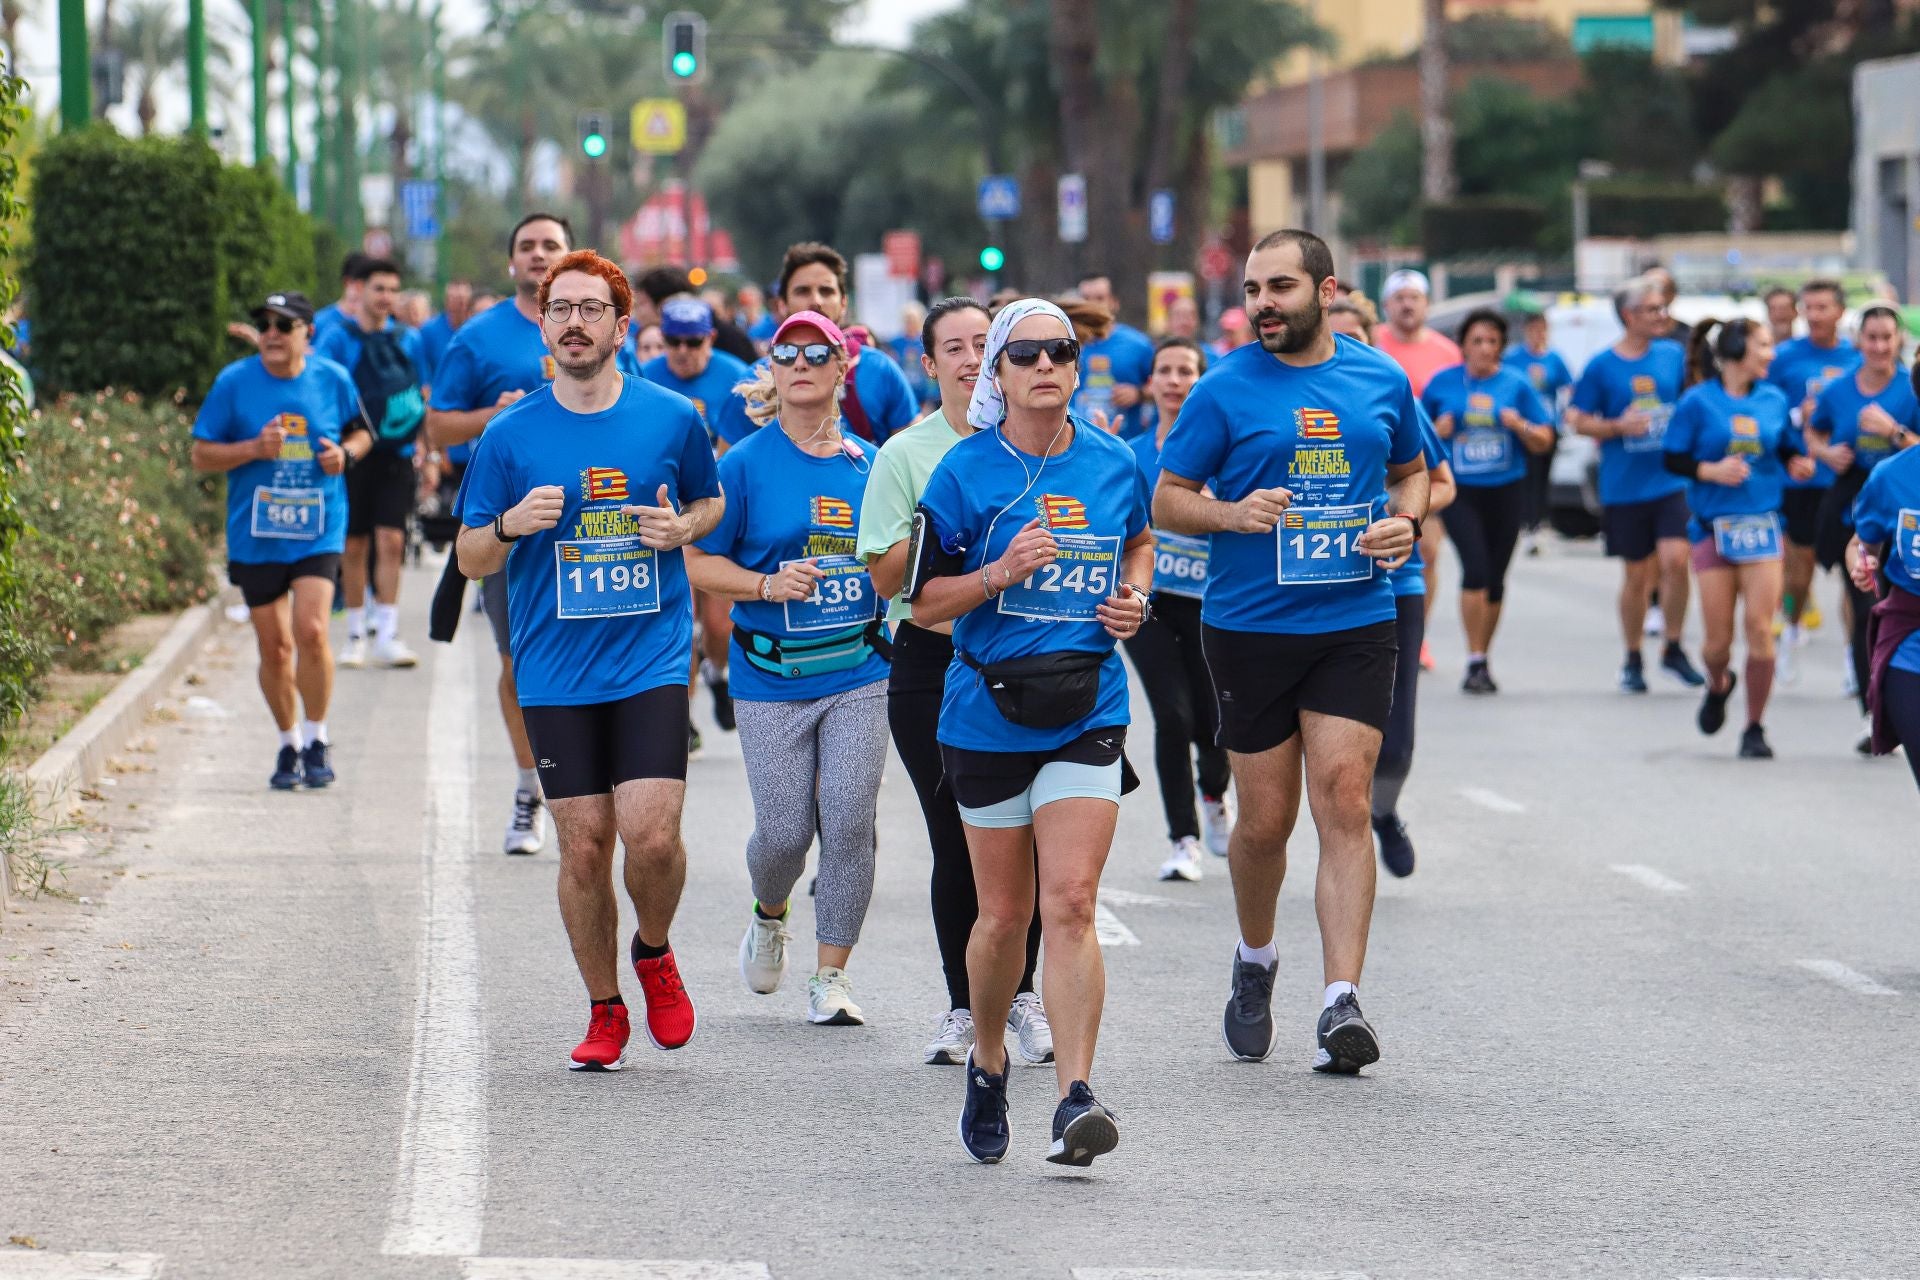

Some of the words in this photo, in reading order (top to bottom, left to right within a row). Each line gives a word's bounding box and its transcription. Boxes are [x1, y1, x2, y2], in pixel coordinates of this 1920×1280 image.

[1295, 448, 1344, 462] MUÉVETE
[1288, 462, 1296, 474] X
[1298, 461, 1350, 475] VALENCIA
[268, 505, 308, 524] 561
[575, 525, 582, 538] X
[586, 522, 640, 538] VALENCIA
[1307, 520, 1337, 529] MUÉVETE
[803, 546, 808, 557] X
[1290, 530, 1364, 559] 1214
[584, 553, 615, 562] MUÉVETE
[622, 550, 652, 560] VALENCIA
[1074, 552, 1080, 560] X
[1082, 552, 1113, 560] VALENCIA
[1154, 553, 1207, 580] 066
[568, 563, 650, 592] 1198
[804, 577, 862, 605] 438
